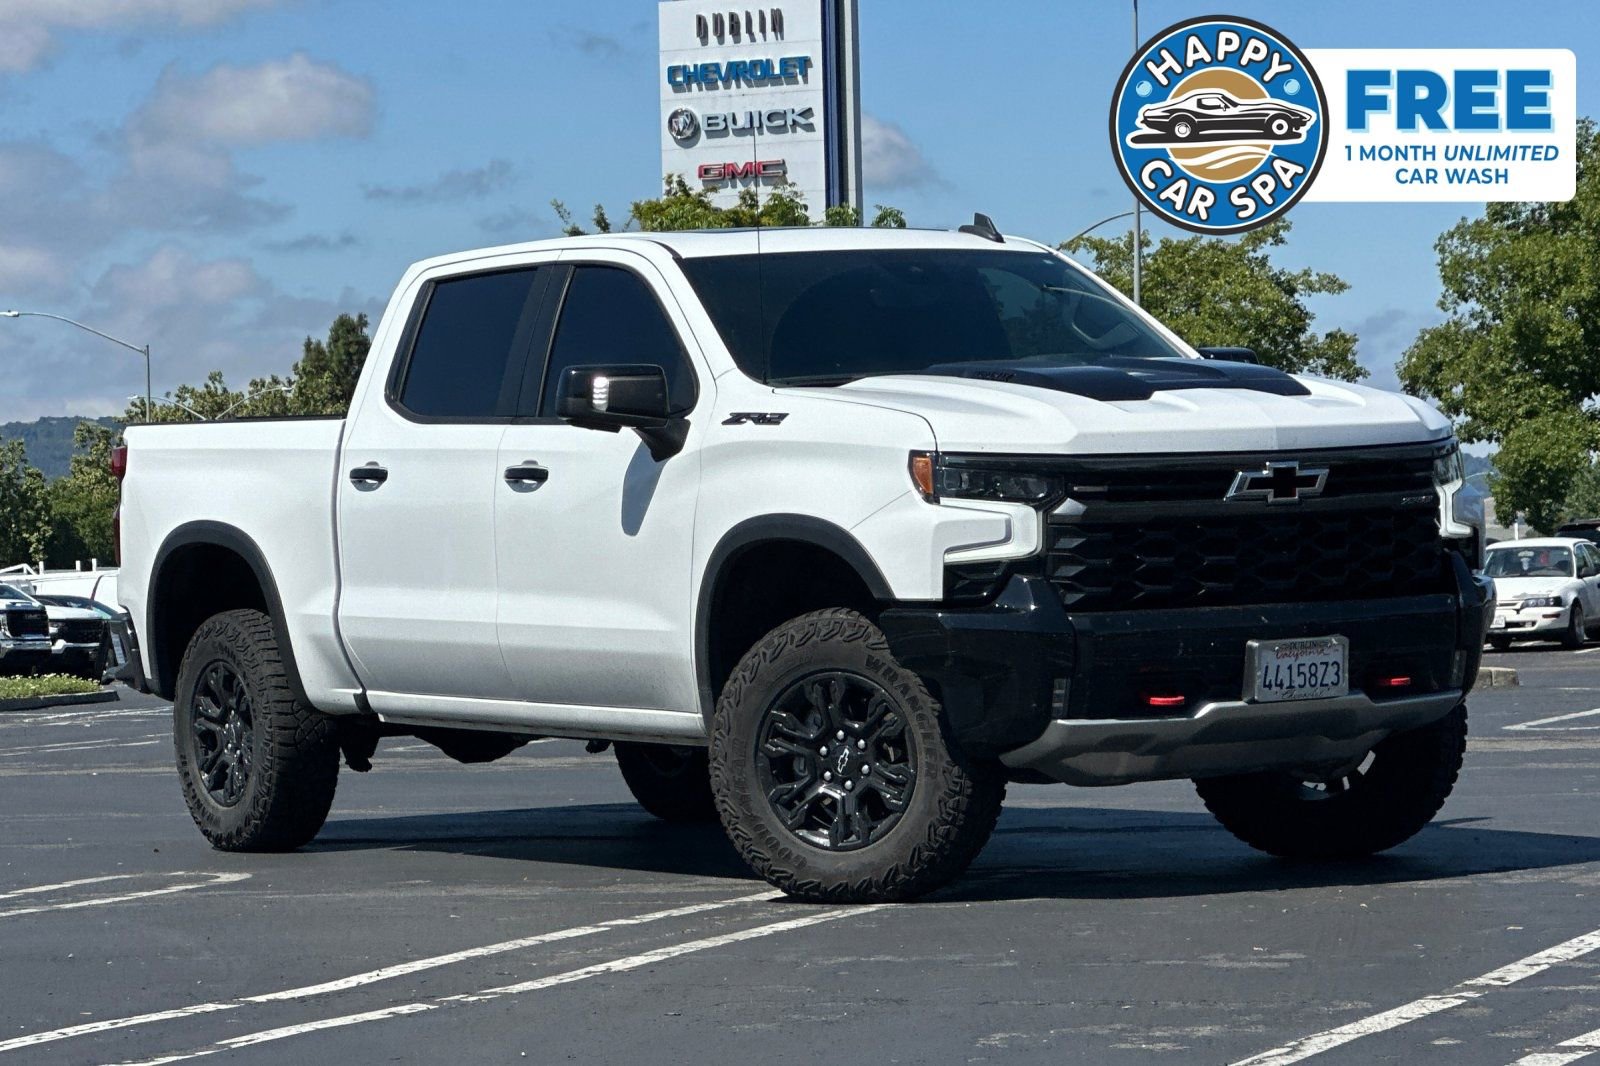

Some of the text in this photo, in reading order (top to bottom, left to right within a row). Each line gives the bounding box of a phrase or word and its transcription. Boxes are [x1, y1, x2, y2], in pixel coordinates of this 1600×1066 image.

[696, 8, 784, 41] DUBLIN
[667, 56, 812, 87] CHEVROLET
[702, 107, 813, 132] BUICK
[698, 160, 786, 181] GMC
[721, 412, 790, 425] ZR2
[1262, 661, 1341, 691] 44158Z3
[865, 654, 939, 780] WRANGLER
